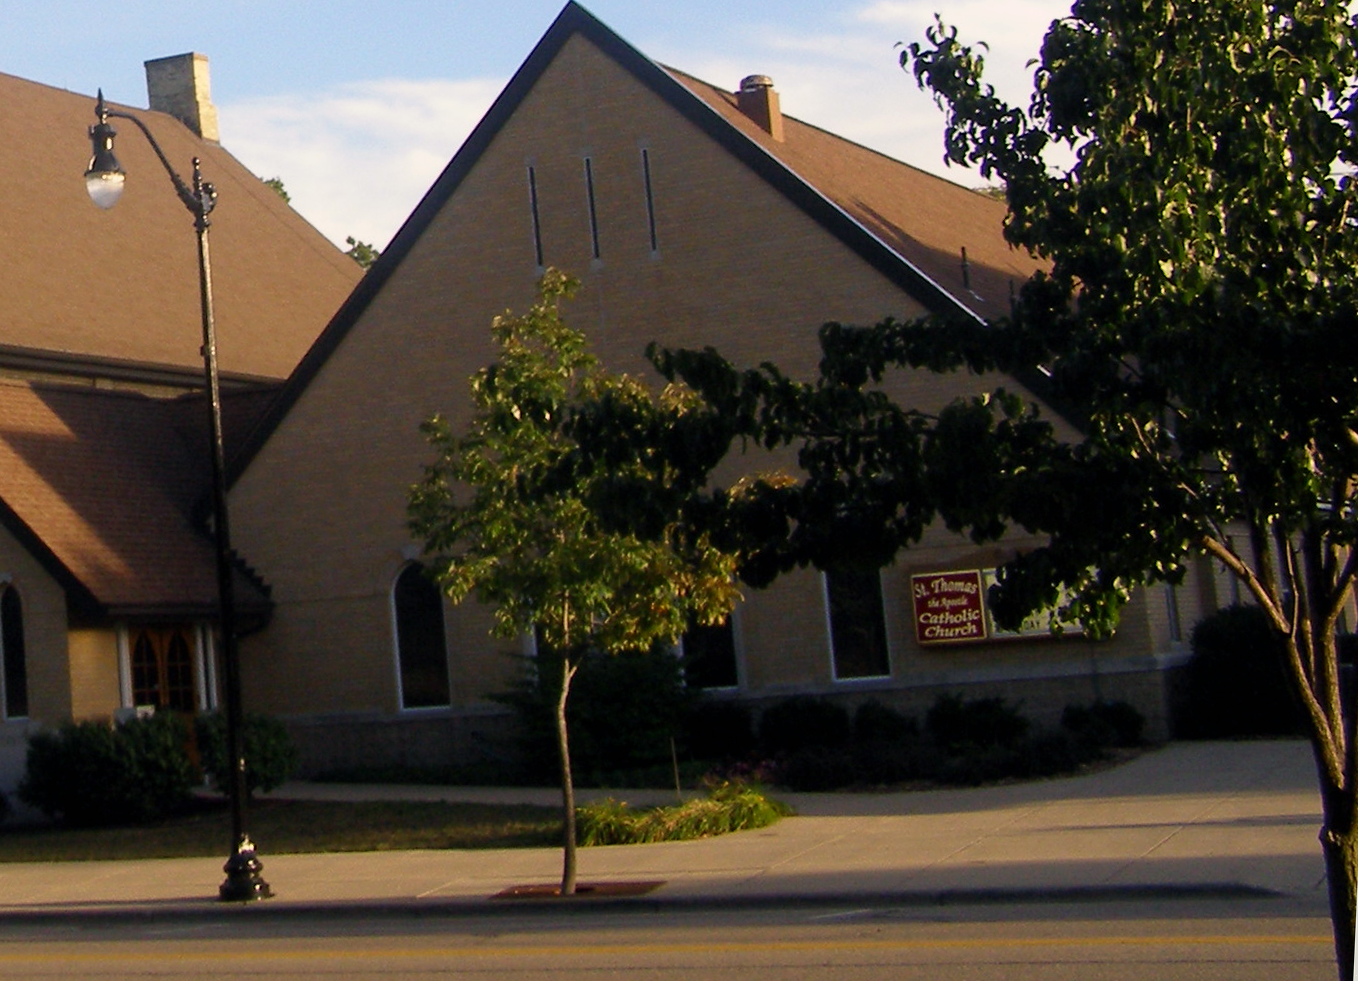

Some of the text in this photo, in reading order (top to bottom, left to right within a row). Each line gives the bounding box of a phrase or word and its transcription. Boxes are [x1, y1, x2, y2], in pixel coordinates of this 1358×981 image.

[914, 577, 978, 598] St. Thomas
[919, 608, 981, 624] Catholic
[924, 622, 977, 638] Church
